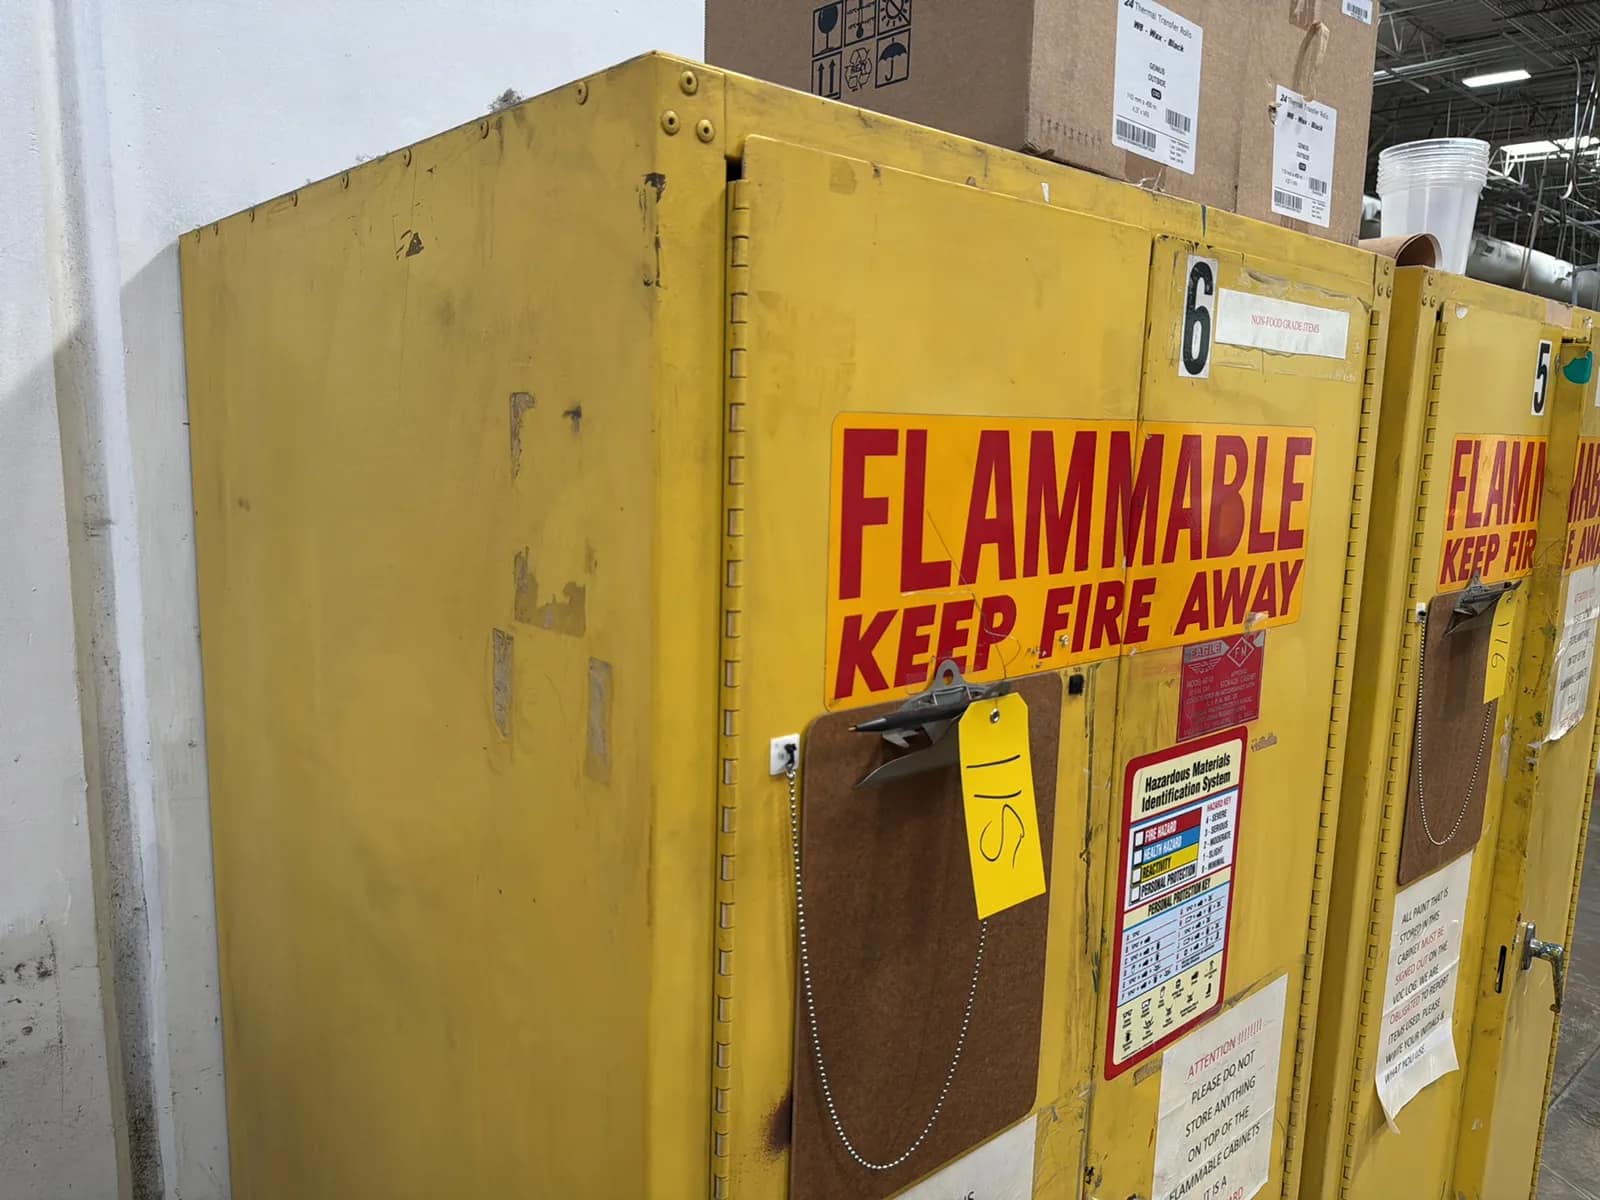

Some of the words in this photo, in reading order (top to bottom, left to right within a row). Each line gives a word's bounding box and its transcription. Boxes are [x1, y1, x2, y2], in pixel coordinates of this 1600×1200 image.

[1158, 14, 1178, 32] Transfer
[1168, 38, 1184, 52] Black
[1182, 261, 1213, 375] 6
[1252, 314, 1282, 328] NON-FOOD
[1283, 320, 1303, 332] GRADE
[1304, 322, 1320, 333] ITEMS
[1534, 342, 1551, 413] 5
[839, 428, 1313, 600] FLAMMABLE
[1440, 533, 1500, 585] KEEP
[834, 594, 1018, 699] KEEP
[1039, 578, 1156, 659] FIRE
[1173, 558, 1304, 636] AWAY
[1142, 784, 1200, 812] Identification
[1202, 771, 1231, 792] System
[1145, 767, 1190, 792] Hazardous
[1192, 753, 1230, 776] Materials
[1142, 876, 1166, 896] PERSONAL
[1167, 863, 1196, 885] PROTECTION
[1144, 856, 1171, 878] REACTIVITY
[1148, 896, 1172, 916] PERSONAL
[1173, 884, 1201, 906] PROTECTION
[1202, 878, 1210, 892] KEY
[1401, 910, 1412, 924] ALL
[1413, 900, 1430, 918] PAINT
[1398, 941, 1420, 965] CABINET
[1421, 931, 1437, 948] MUST
[1400, 923, 1421, 945] STORED
[1394, 963, 1415, 985] SIGNED
[1416, 954, 1428, 970] OUT
[1429, 950, 1436, 961] ON
[1390, 995, 1420, 1024] OBLIGATED
[1421, 989, 1428, 1001] TO
[1430, 973, 1449, 994] REPORT
[1388, 1024, 1404, 1045] ITEMS
[1422, 997, 1441, 1018] PLEASE
[1187, 1036, 1236, 1079] ATTENTION
[1385, 1042, 1403, 1064] WRITE
[1405, 1031, 1420, 1048] YOUR
[1192, 1074, 1221, 1104] PLEASE
[1223, 1064, 1236, 1081] DO
[1238, 1049, 1255, 1072] NOT
[1385, 1062, 1401, 1084] WHAT
[1402, 1053, 1415, 1069] YOU
[1185, 1108, 1212, 1138] STORE
[1214, 1076, 1256, 1116] ANYTHING
[1188, 1143, 1201, 1163] ON
[1203, 1129, 1220, 1150] TOP
[1221, 1118, 1233, 1136] OF
[1234, 1105, 1250, 1124] THE
[1169, 1152, 1222, 1200] FLAMMABLE
[1223, 1122, 1260, 1160] CABINETS
[1213, 1181, 1219, 1195] IS
[1221, 1176, 1227, 1187] A
